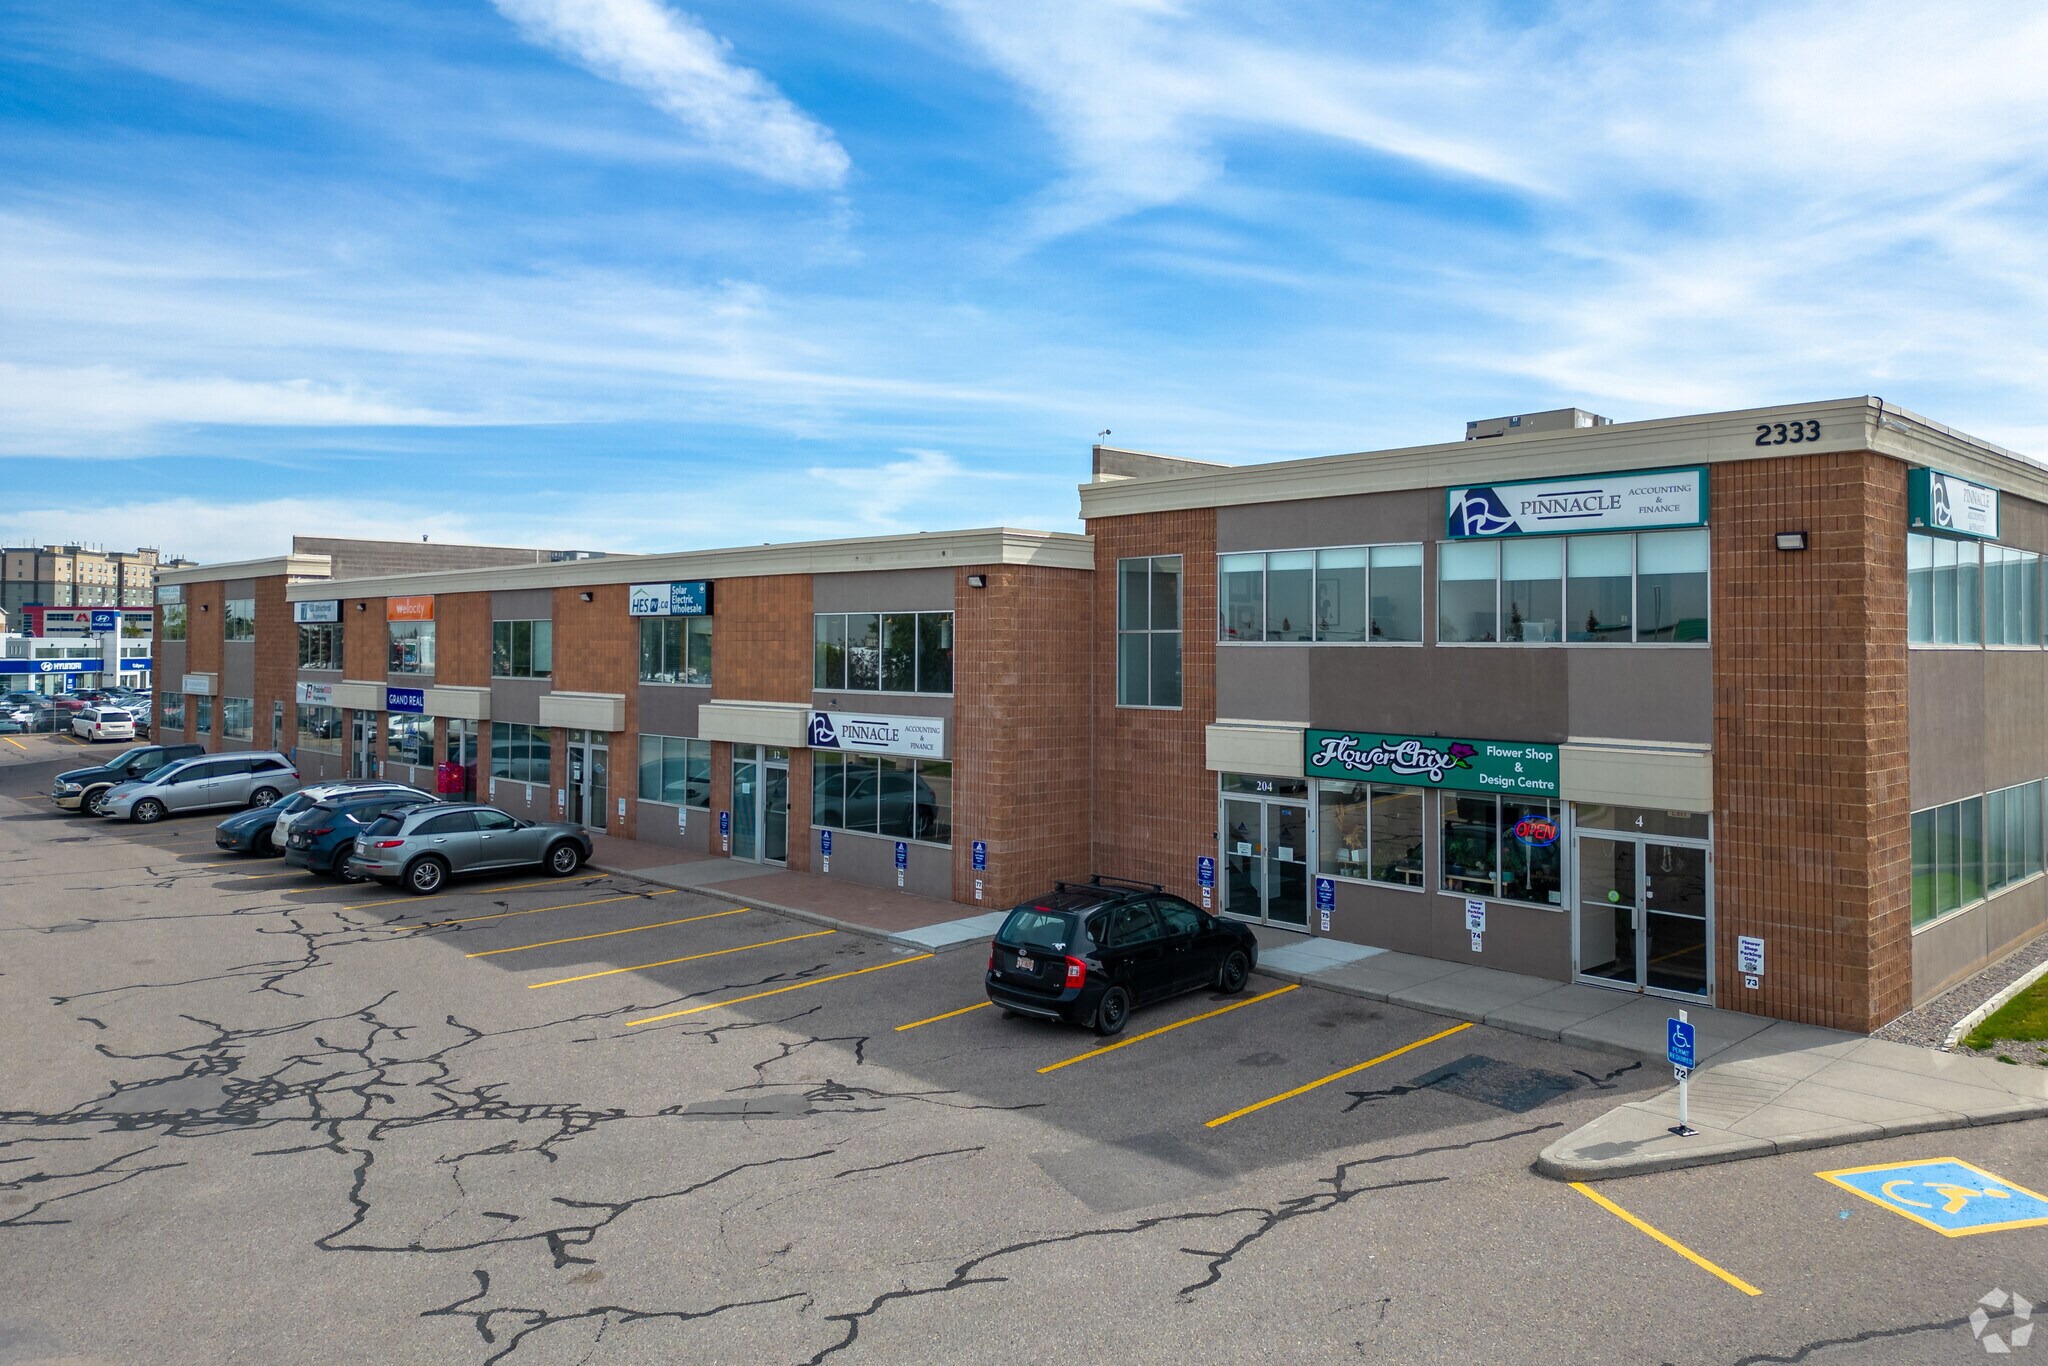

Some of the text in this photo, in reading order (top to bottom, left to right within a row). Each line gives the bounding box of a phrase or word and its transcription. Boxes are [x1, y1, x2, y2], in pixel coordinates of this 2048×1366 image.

[1755, 420, 1820, 446] 2333
[1628, 484, 1692, 496] ACCOUNTING
[1963, 488, 1990, 508] PINNACLE
[1520, 495, 1622, 515] PINNACLE
[1638, 504, 1681, 514] FINANCE
[671, 586, 688, 595] Solar
[632, 598, 649, 613] HES
[671, 595, 694, 604] Electric
[671, 603, 702, 613] Wholesale
[53, 662, 82, 670] HYUNDAI
[388, 694, 408, 705] GRAND
[841, 725, 900, 742] PINNACLE
[904, 725, 940, 734] ACCOUNTING
[910, 742, 935, 751] FINANCE
[774, 750, 780, 759] 12
[1312, 736, 1457, 782] Flower Chix
[1486, 745, 1553, 761] Flower Shop
[1514, 762, 1523, 773] &
[1256, 780, 1273, 792] 204
[1479, 773, 1555, 791] Design Centre
[1635, 815, 1644, 828] 4
[1515, 821, 1557, 841] OPEN
[1740, 950, 1762, 958] Parking
[1746, 978, 1758, 987] 73
[1671, 1046, 1690, 1057] PERMIT
[1669, 1051, 1693, 1066] REQUIRED
[1674, 1067, 1687, 1079] 72
